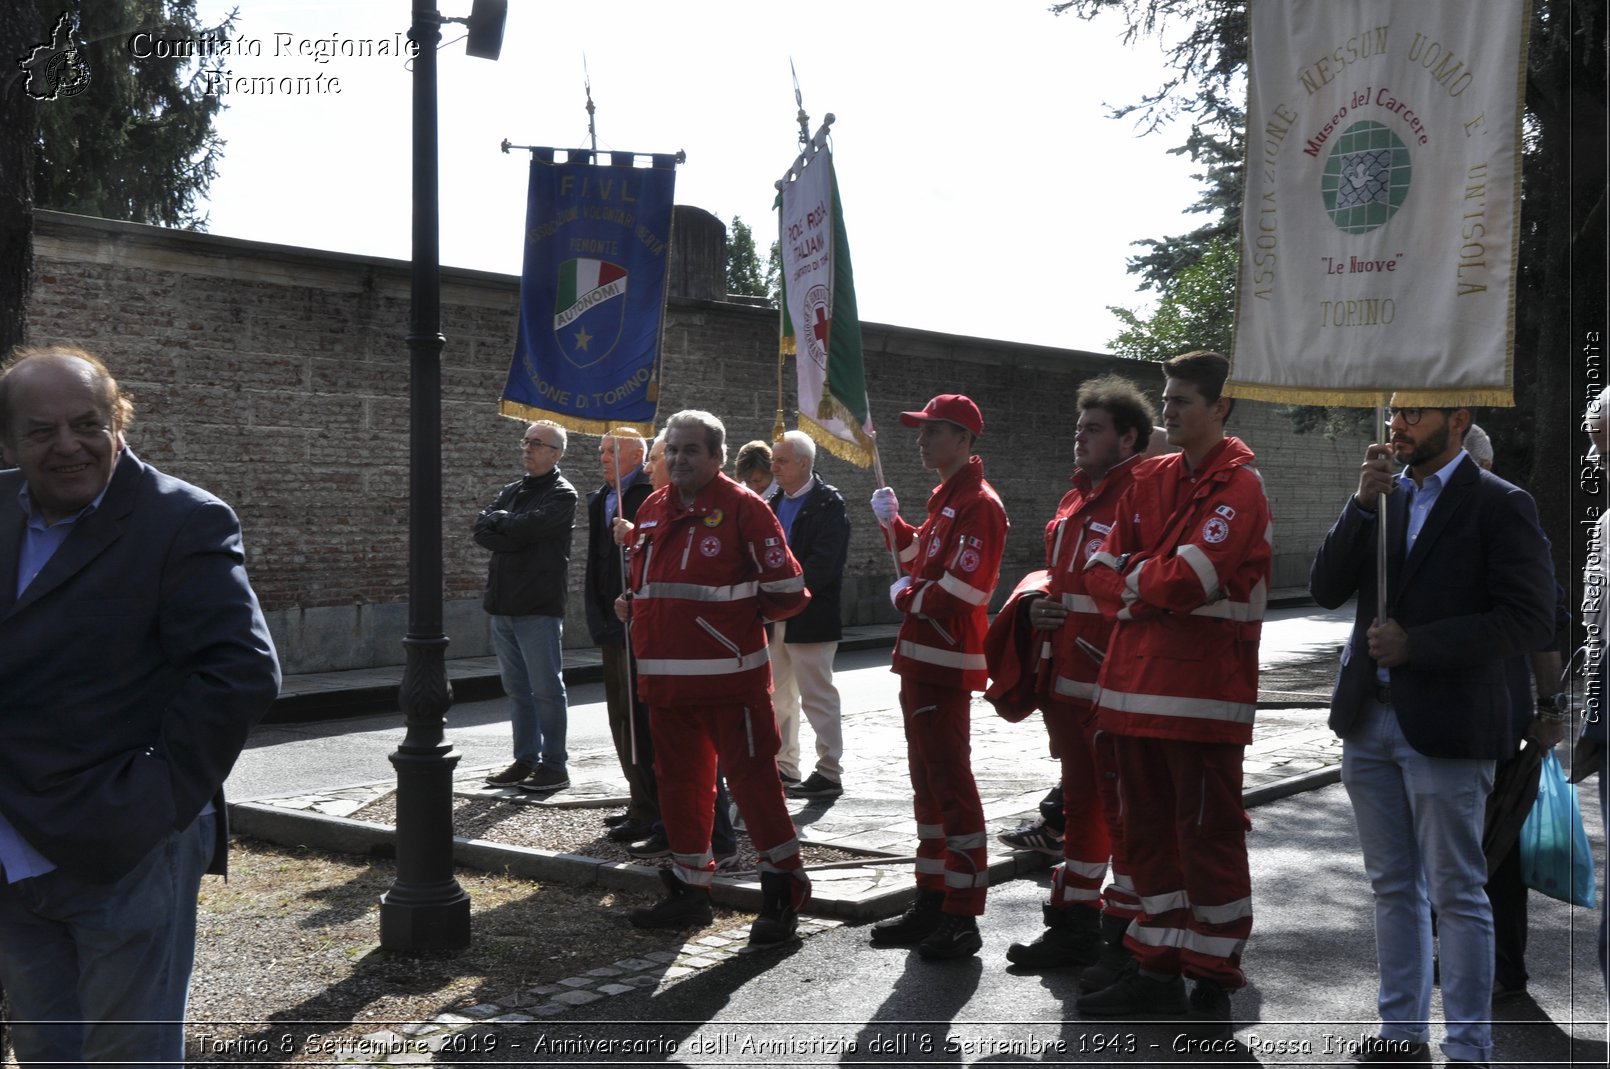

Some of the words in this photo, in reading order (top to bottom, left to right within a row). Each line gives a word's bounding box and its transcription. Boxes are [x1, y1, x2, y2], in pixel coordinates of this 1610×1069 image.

[1299, 25, 1389, 96] NESSUN
[1408, 32, 1473, 97] UOMO
[1303, 106, 1347, 158] Museo
[1350, 87, 1372, 109] del
[1375, 88, 1428, 146] Carcere
[1321, 257, 1344, 275] "Le
[1349, 253, 1403, 274] Nuove"
[557, 283, 620, 326] AUTONOMI
[1320, 298, 1396, 328] TORINO
[576, 395, 589, 409] DI
[592, 368, 650, 407] TORINO
